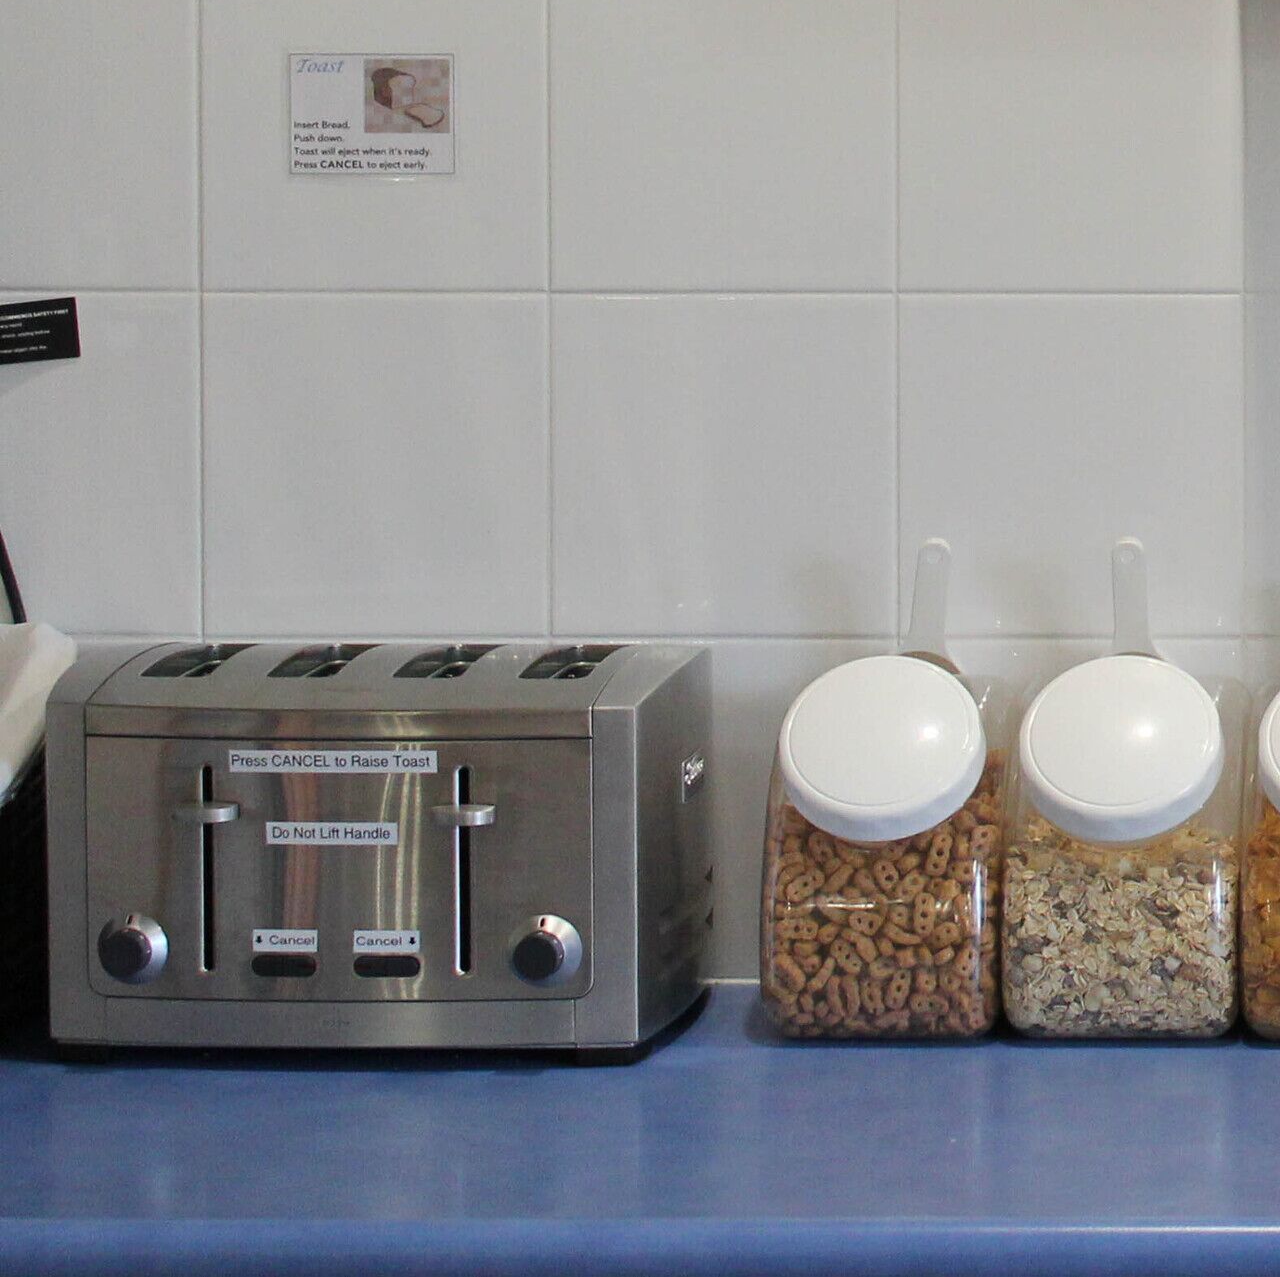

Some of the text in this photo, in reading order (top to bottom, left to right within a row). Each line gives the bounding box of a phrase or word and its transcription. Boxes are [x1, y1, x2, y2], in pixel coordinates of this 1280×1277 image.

[296, 58, 344, 73] Toast
[294, 121, 319, 130] Insert
[294, 135, 314, 143] Push
[294, 147, 318, 156] Toast
[321, 147, 336, 156] will
[338, 148, 359, 158] eject
[362, 148, 387, 156] when
[388, 148, 402, 156] it's
[294, 161, 318, 169] Press
[320, 160, 364, 169] CANCEL
[367, 161, 377, 169] to
[379, 161, 401, 172] eject
[231, 754, 430, 767] Press CANCEL to Raise Toast
[272, 826, 391, 839] Do Not Lift Handle
[269, 935, 315, 946] Cancel
[356, 936, 402, 946] Cancel
